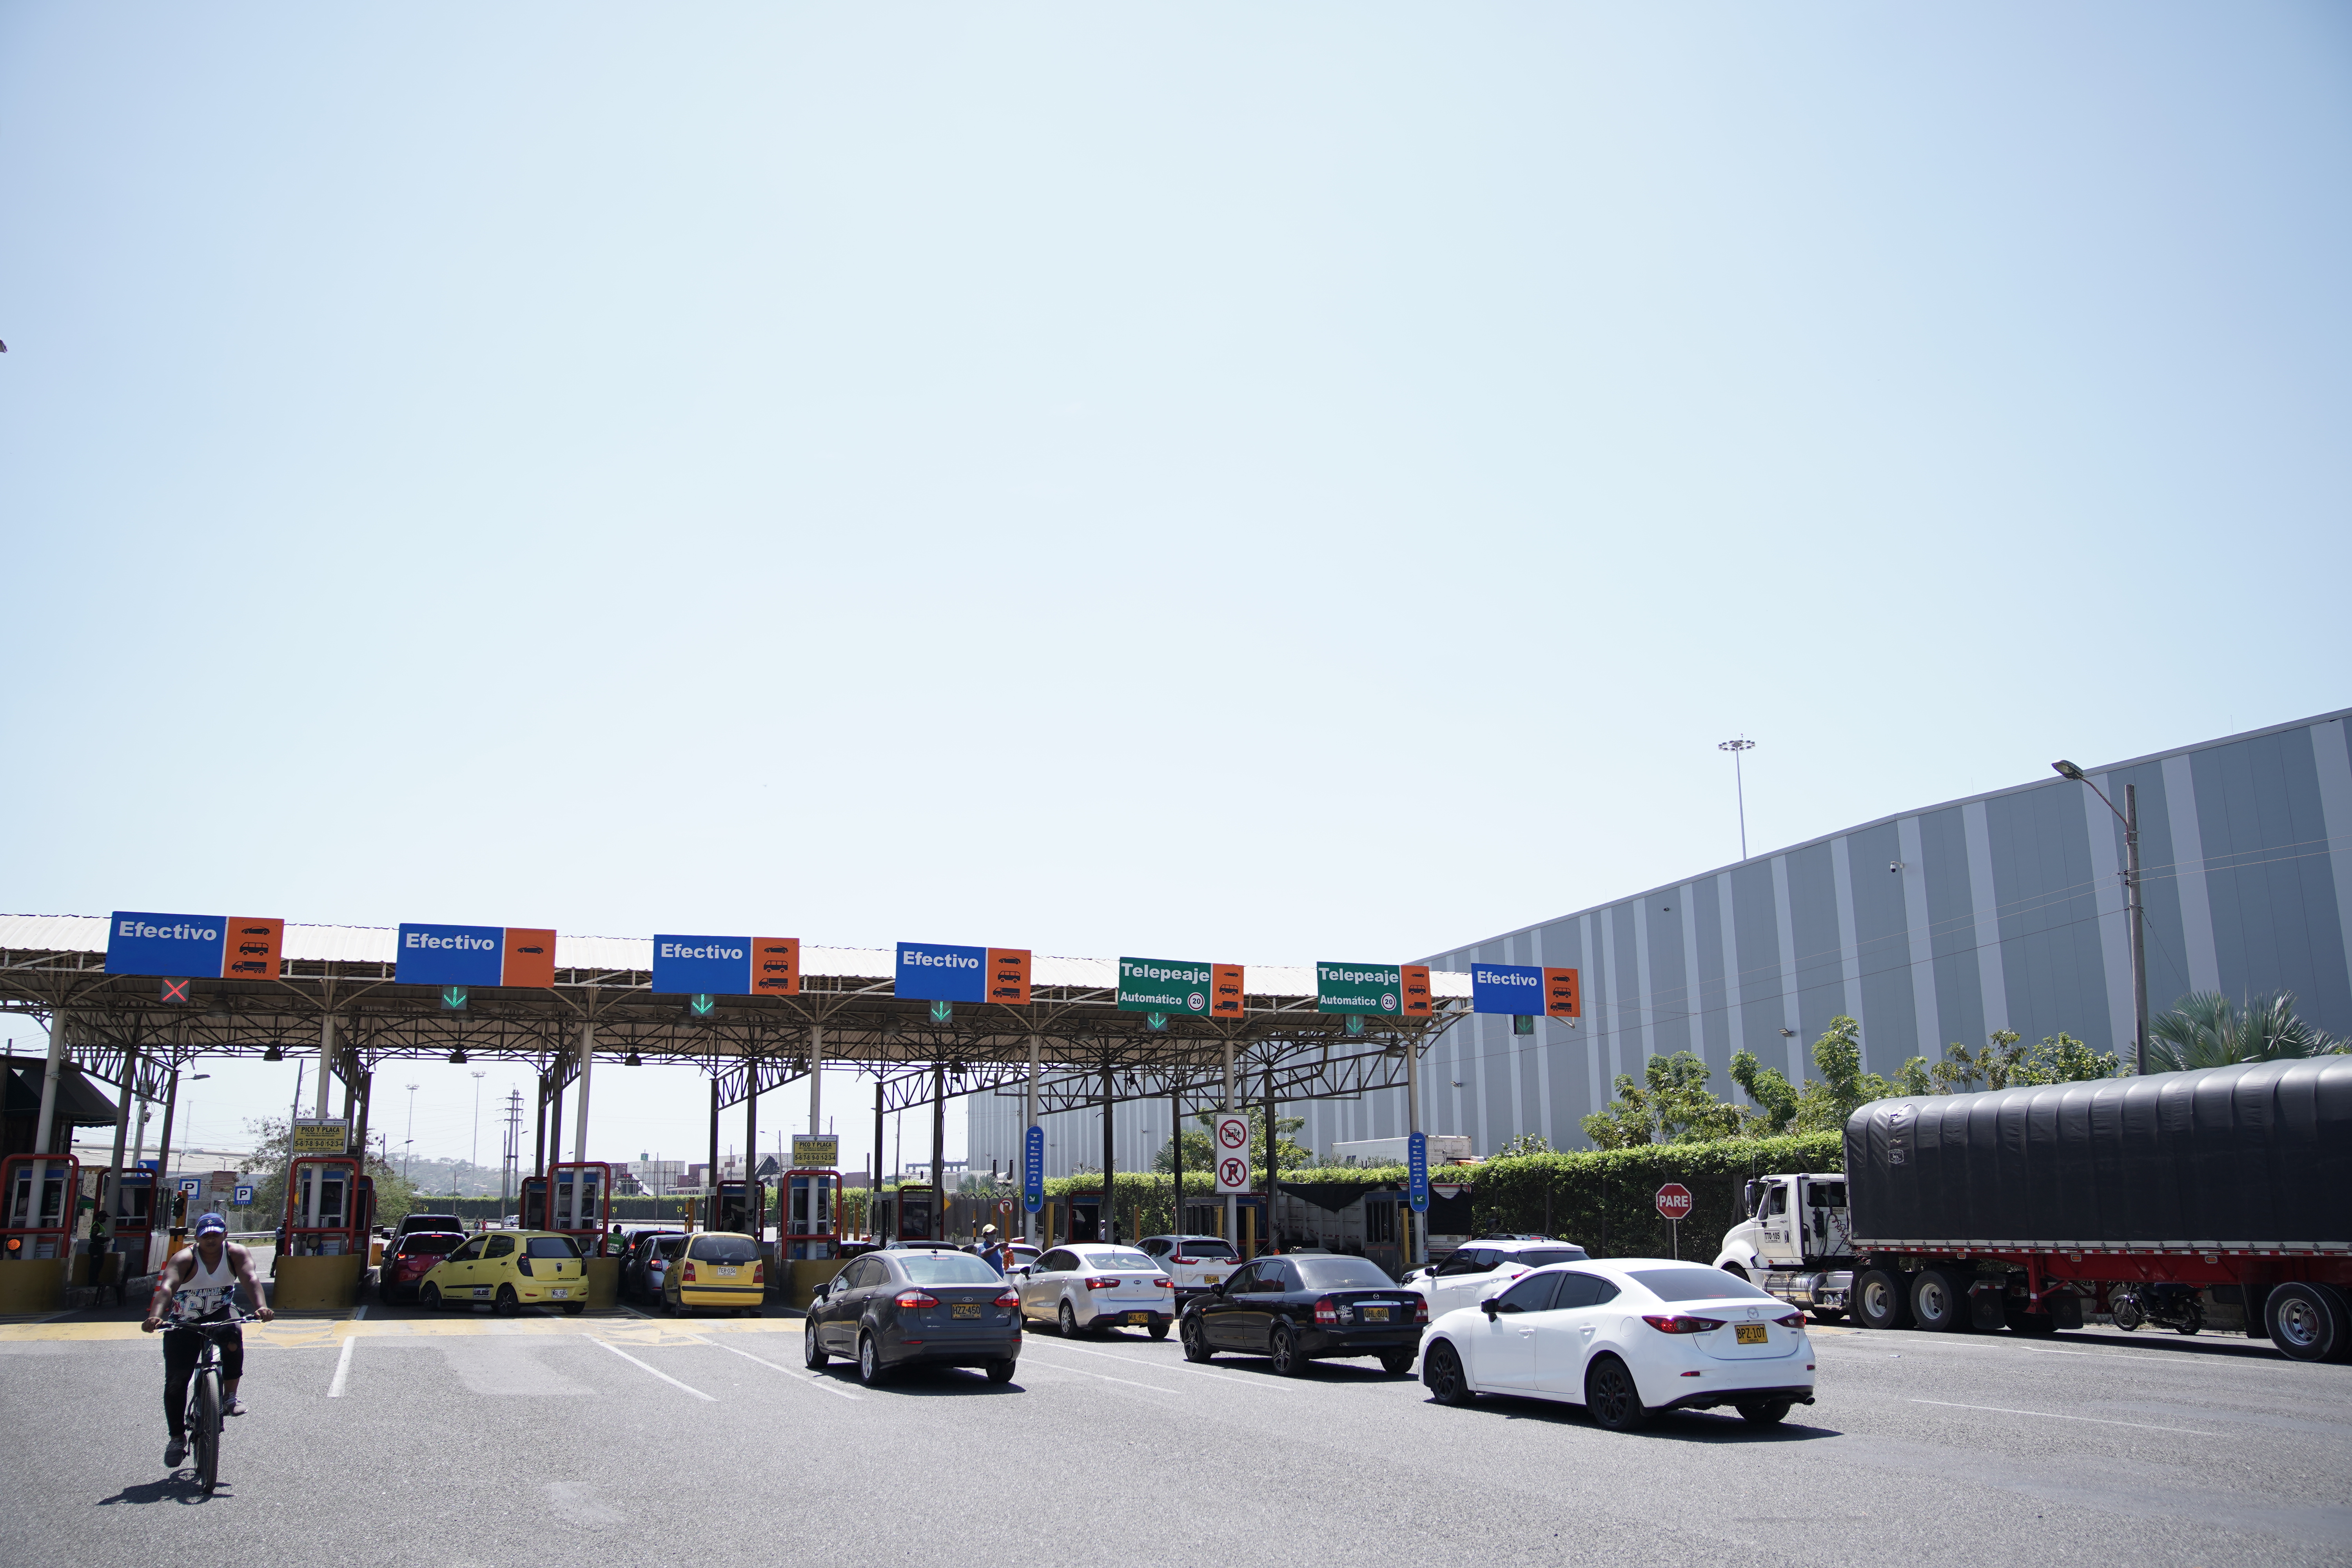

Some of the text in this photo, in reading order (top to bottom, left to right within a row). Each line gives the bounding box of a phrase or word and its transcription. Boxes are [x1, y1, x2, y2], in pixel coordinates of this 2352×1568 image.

[119, 921, 216, 940] Efectivo
[406, 933, 494, 950] Efectivo
[661, 943, 743, 959] Efectivo
[903, 951, 978, 969] Efectivo
[1121, 963, 1210, 984] Telepeaje
[1318, 967, 1399, 985] Telepeaje
[1477, 971, 1537, 986] Efectivo
[1120, 991, 1182, 1005] Automático
[1320, 995, 1376, 1006] Automático
[1659, 1195, 1688, 1207] PARE
